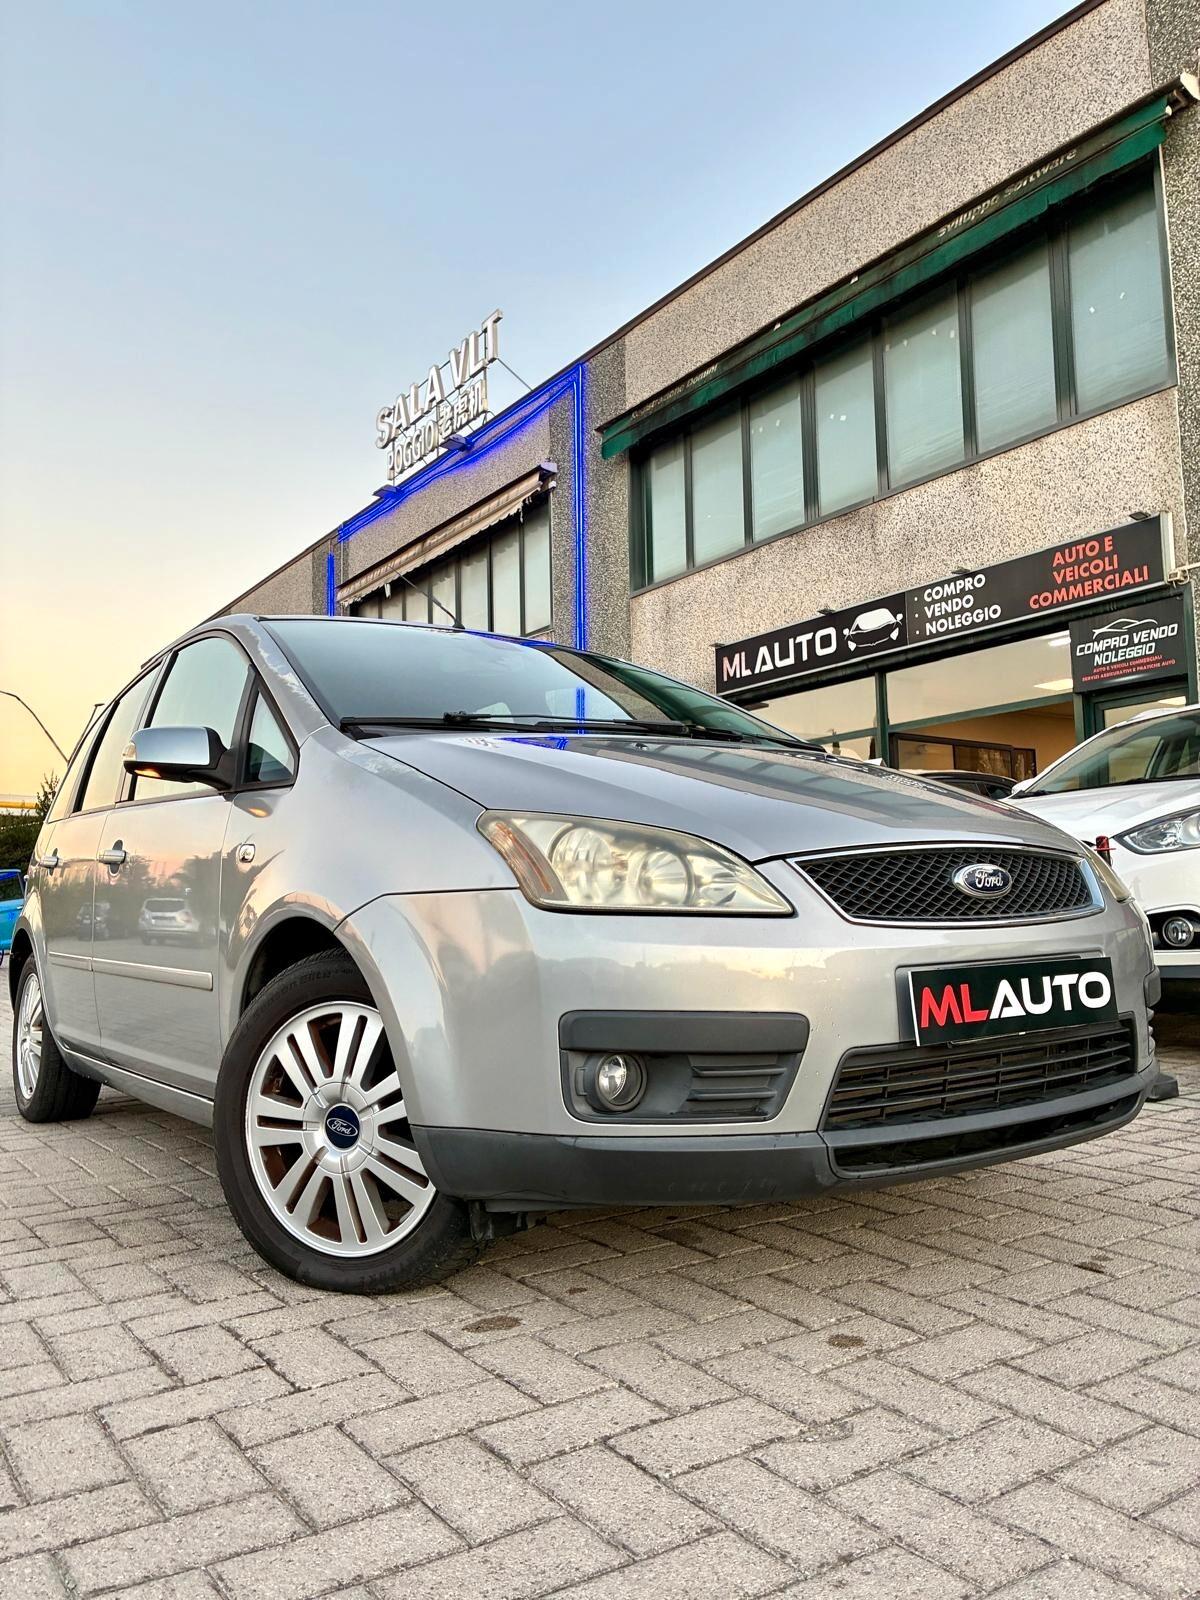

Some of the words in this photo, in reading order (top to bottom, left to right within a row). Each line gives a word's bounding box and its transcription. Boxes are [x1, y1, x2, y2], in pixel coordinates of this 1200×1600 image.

[376, 365, 446, 449] SALA
[449, 308, 503, 390] VLT
[387, 420, 439, 480] POGGIO
[1052, 540, 1100, 567] AUTO
[1104, 535, 1114, 551] E
[1053, 554, 1118, 585] VEICOLI
[924, 573, 986, 602] COMPRO
[1029, 565, 1149, 610] COMMERCIALI
[924, 594, 974, 619] VENDO
[925, 604, 1002, 636] NOLEGGIO
[1076, 634, 1129, 657] COMPRO
[1132, 623, 1178, 644] VENDO
[1094, 642, 1155, 666] NOLEGGIO
[1130, 655, 1163, 666] COMMERCIALI
[1137, 662, 1160, 671] PRATICHE
[1162, 658, 1176, 666] AUTO
[975, 868, 1004, 888] Ford
[331, 1120, 352, 1135] Ford
